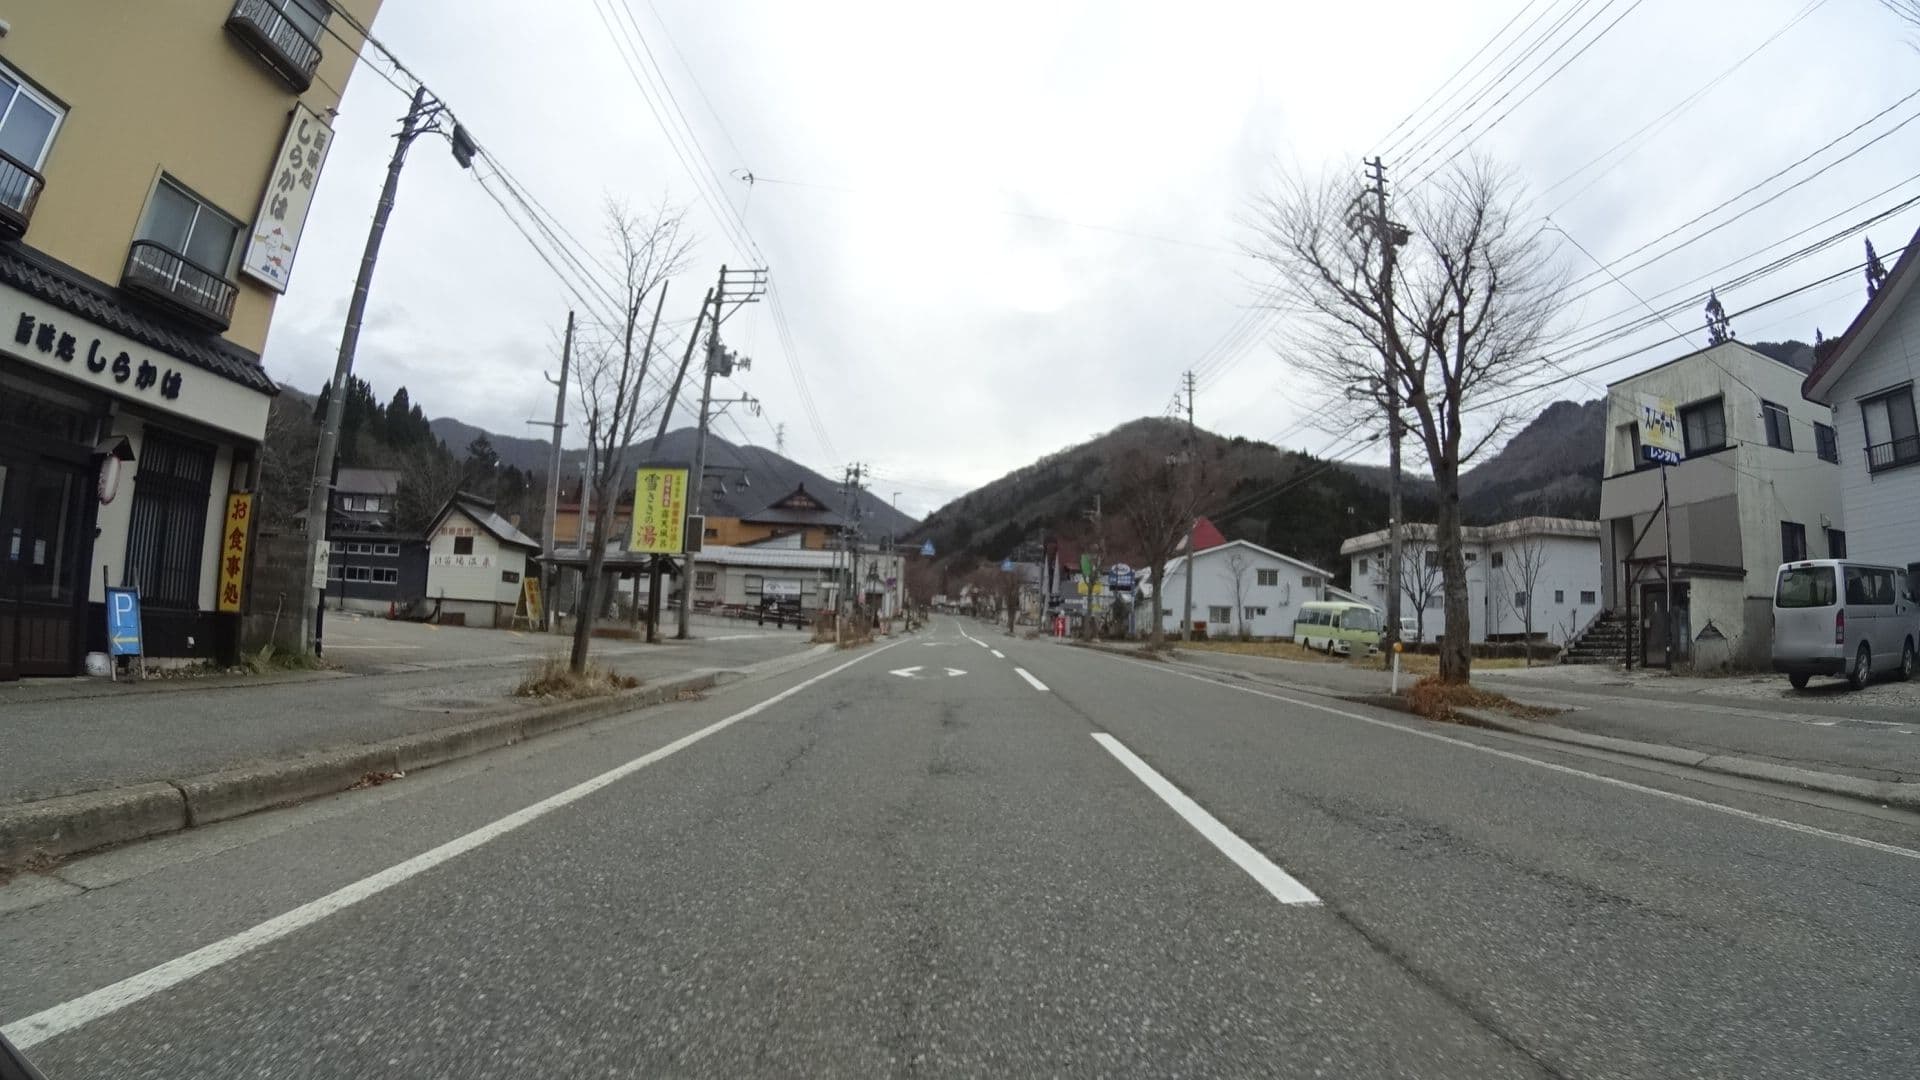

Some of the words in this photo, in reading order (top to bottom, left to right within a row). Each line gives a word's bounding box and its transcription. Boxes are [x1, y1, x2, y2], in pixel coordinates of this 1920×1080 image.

[14, 311, 77, 363] 旨味処
[1644, 406, 1675, 439] スノーボード
[1650, 446, 1678, 464] レンタル
[223, 498, 248, 604] お食事処
[114, 593, 133, 626] P
